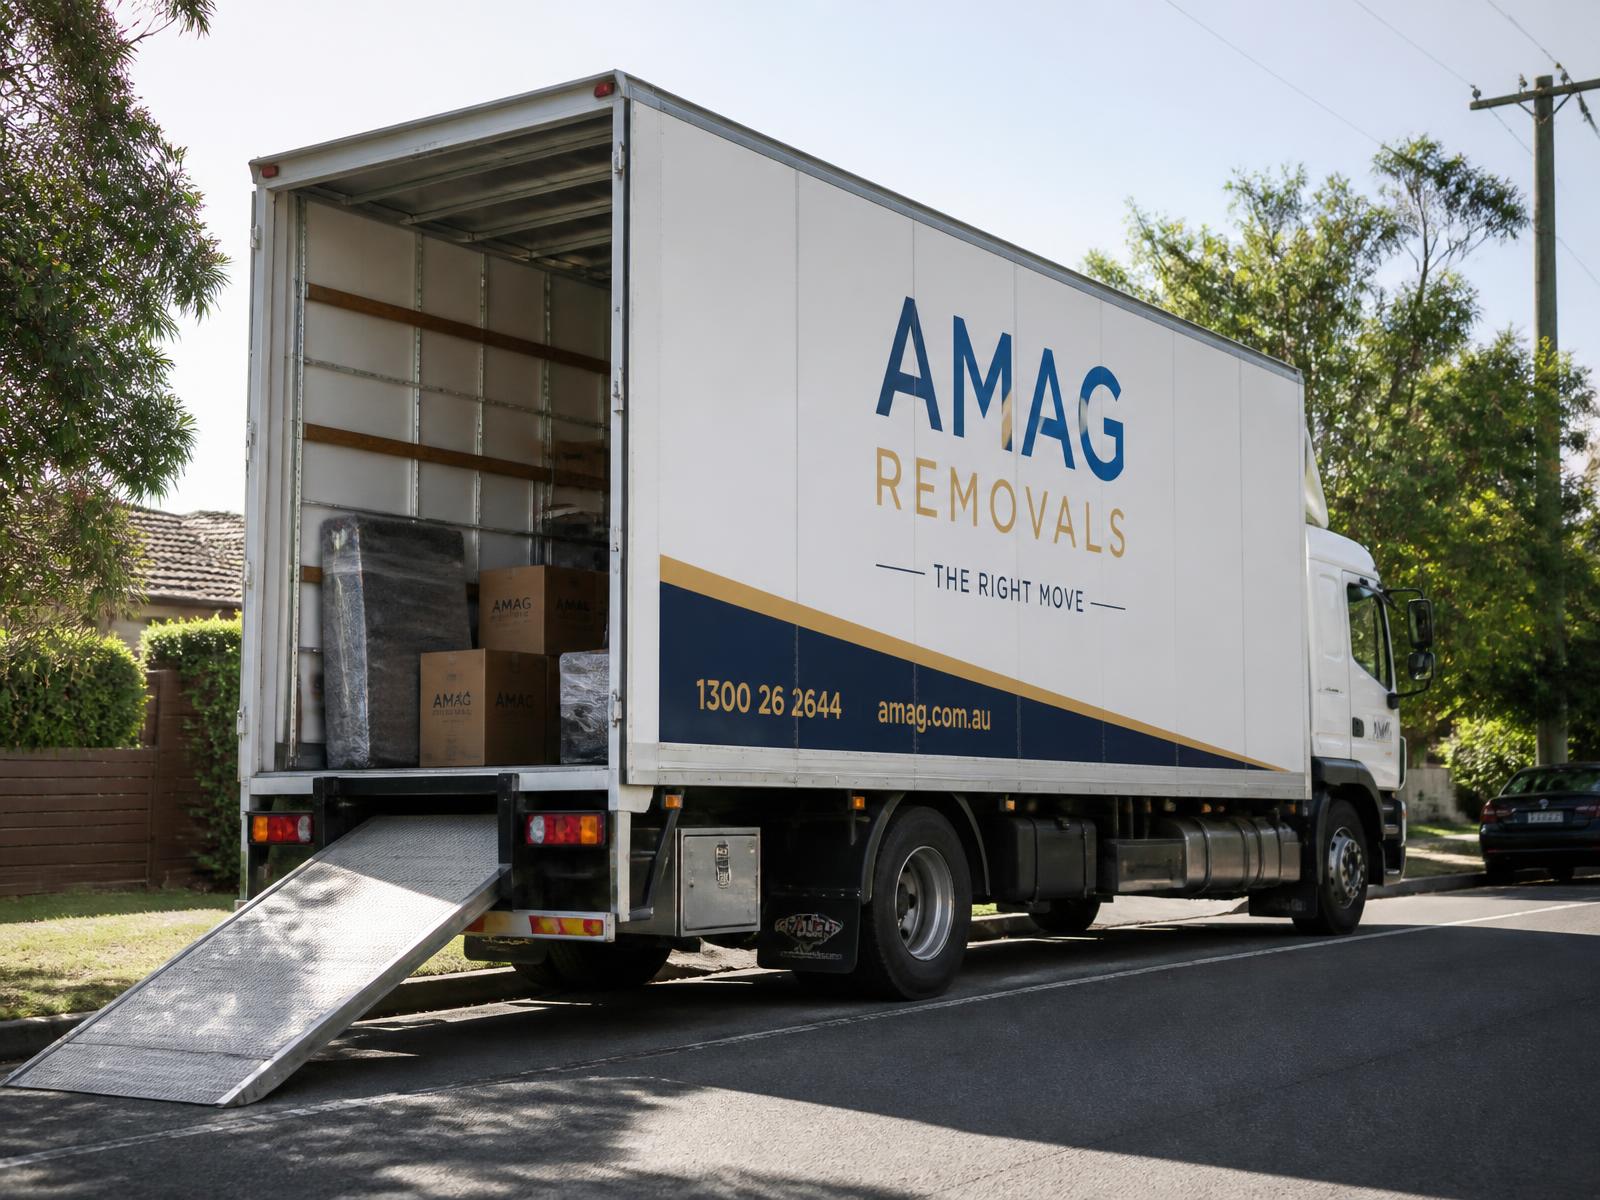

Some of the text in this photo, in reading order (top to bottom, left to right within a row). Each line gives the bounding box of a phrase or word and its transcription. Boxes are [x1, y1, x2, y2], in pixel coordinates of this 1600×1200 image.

[875, 296, 1125, 482] AMAG
[876, 446, 1126, 559] REMOVALS
[492, 596, 532, 612] AMAG
[933, 563, 1084, 613] THE RIGHT MOVE
[696, 678, 842, 720] 1300 26 2644
[877, 699, 991, 734] amag.com.au
